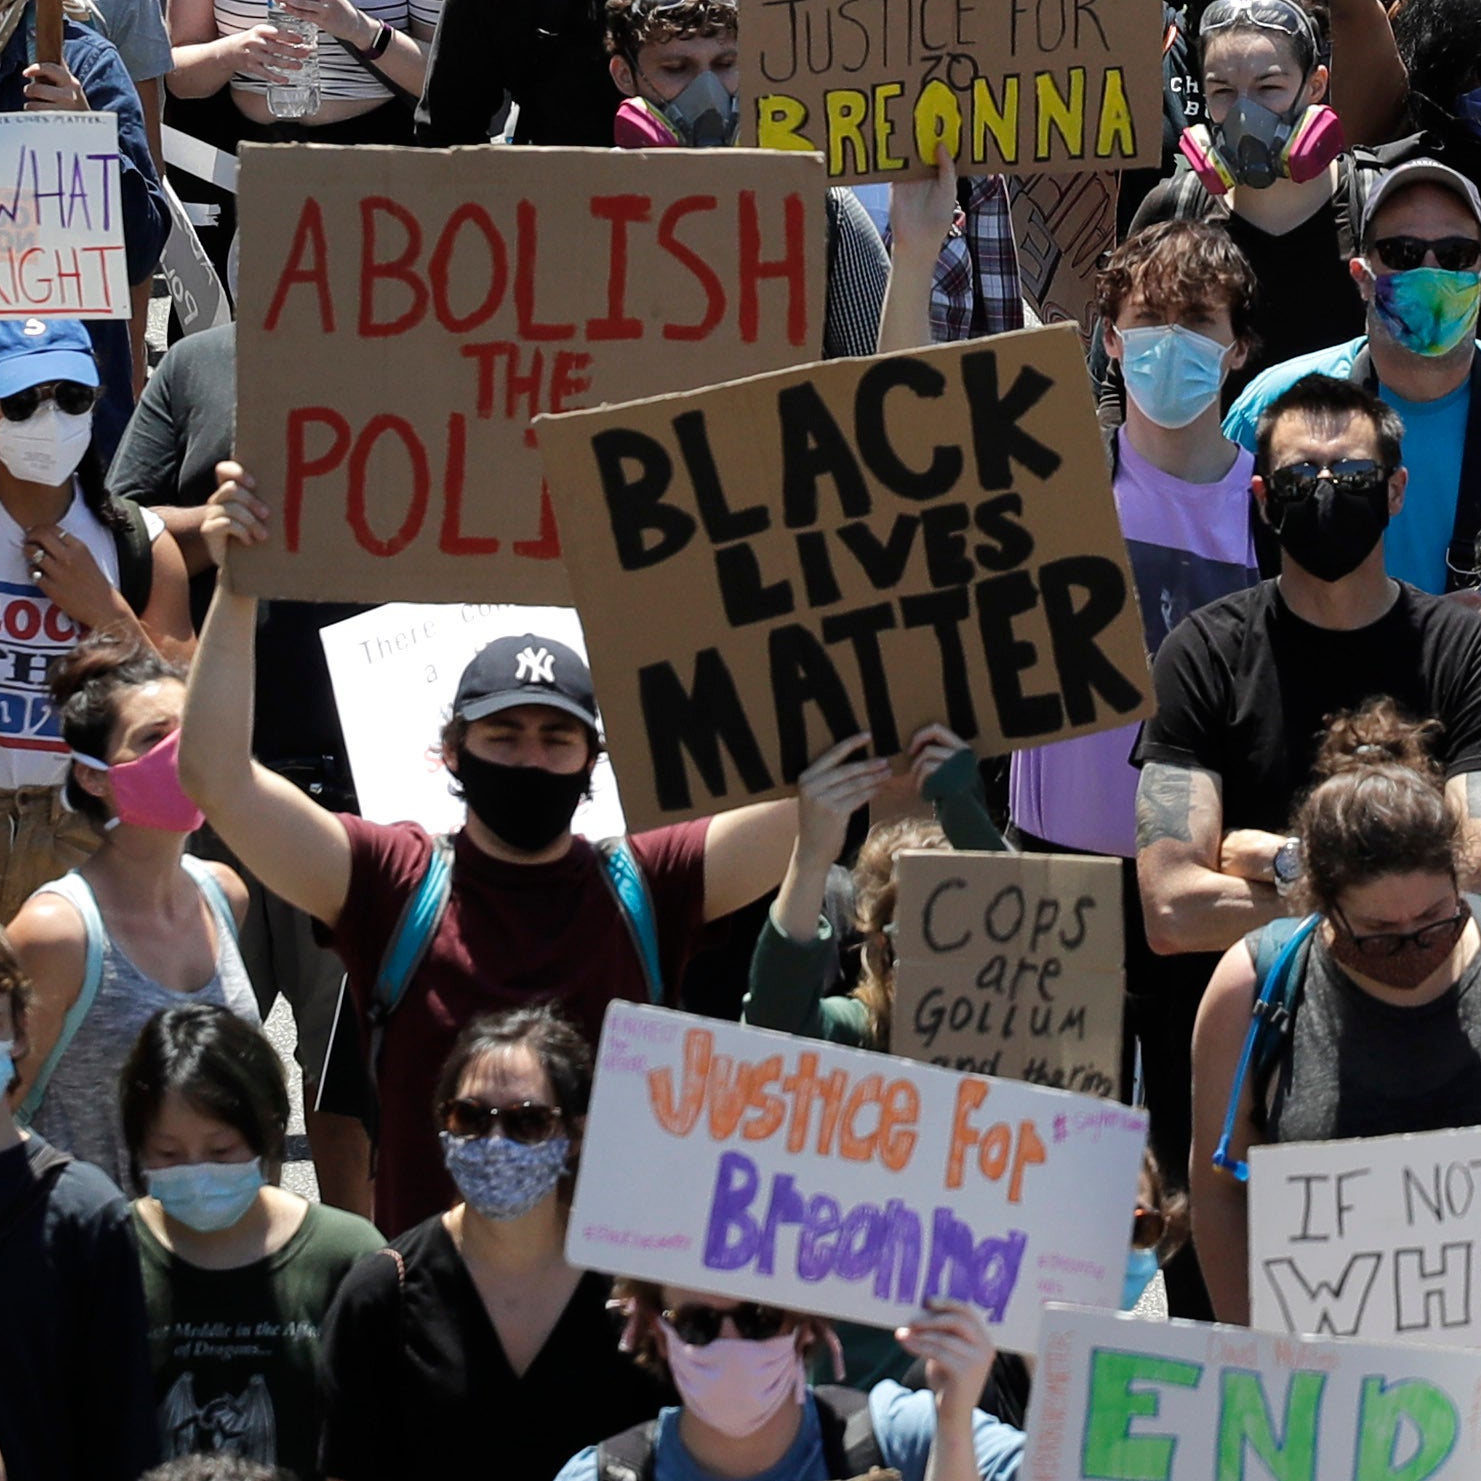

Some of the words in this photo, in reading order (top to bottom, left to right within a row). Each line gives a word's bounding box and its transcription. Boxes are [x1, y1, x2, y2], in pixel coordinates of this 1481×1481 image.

[263, 190, 807, 346] ABOLISH
[460, 339, 593, 420] THE
[591, 350, 1063, 572] BLACK
[714, 491, 1035, 628] LIVES
[638, 554, 1145, 813] MATTER
[976, 954, 1063, 1002] are
[1286, 1167, 1371, 1243] IF
[1081, 1345, 1460, 1481] END
